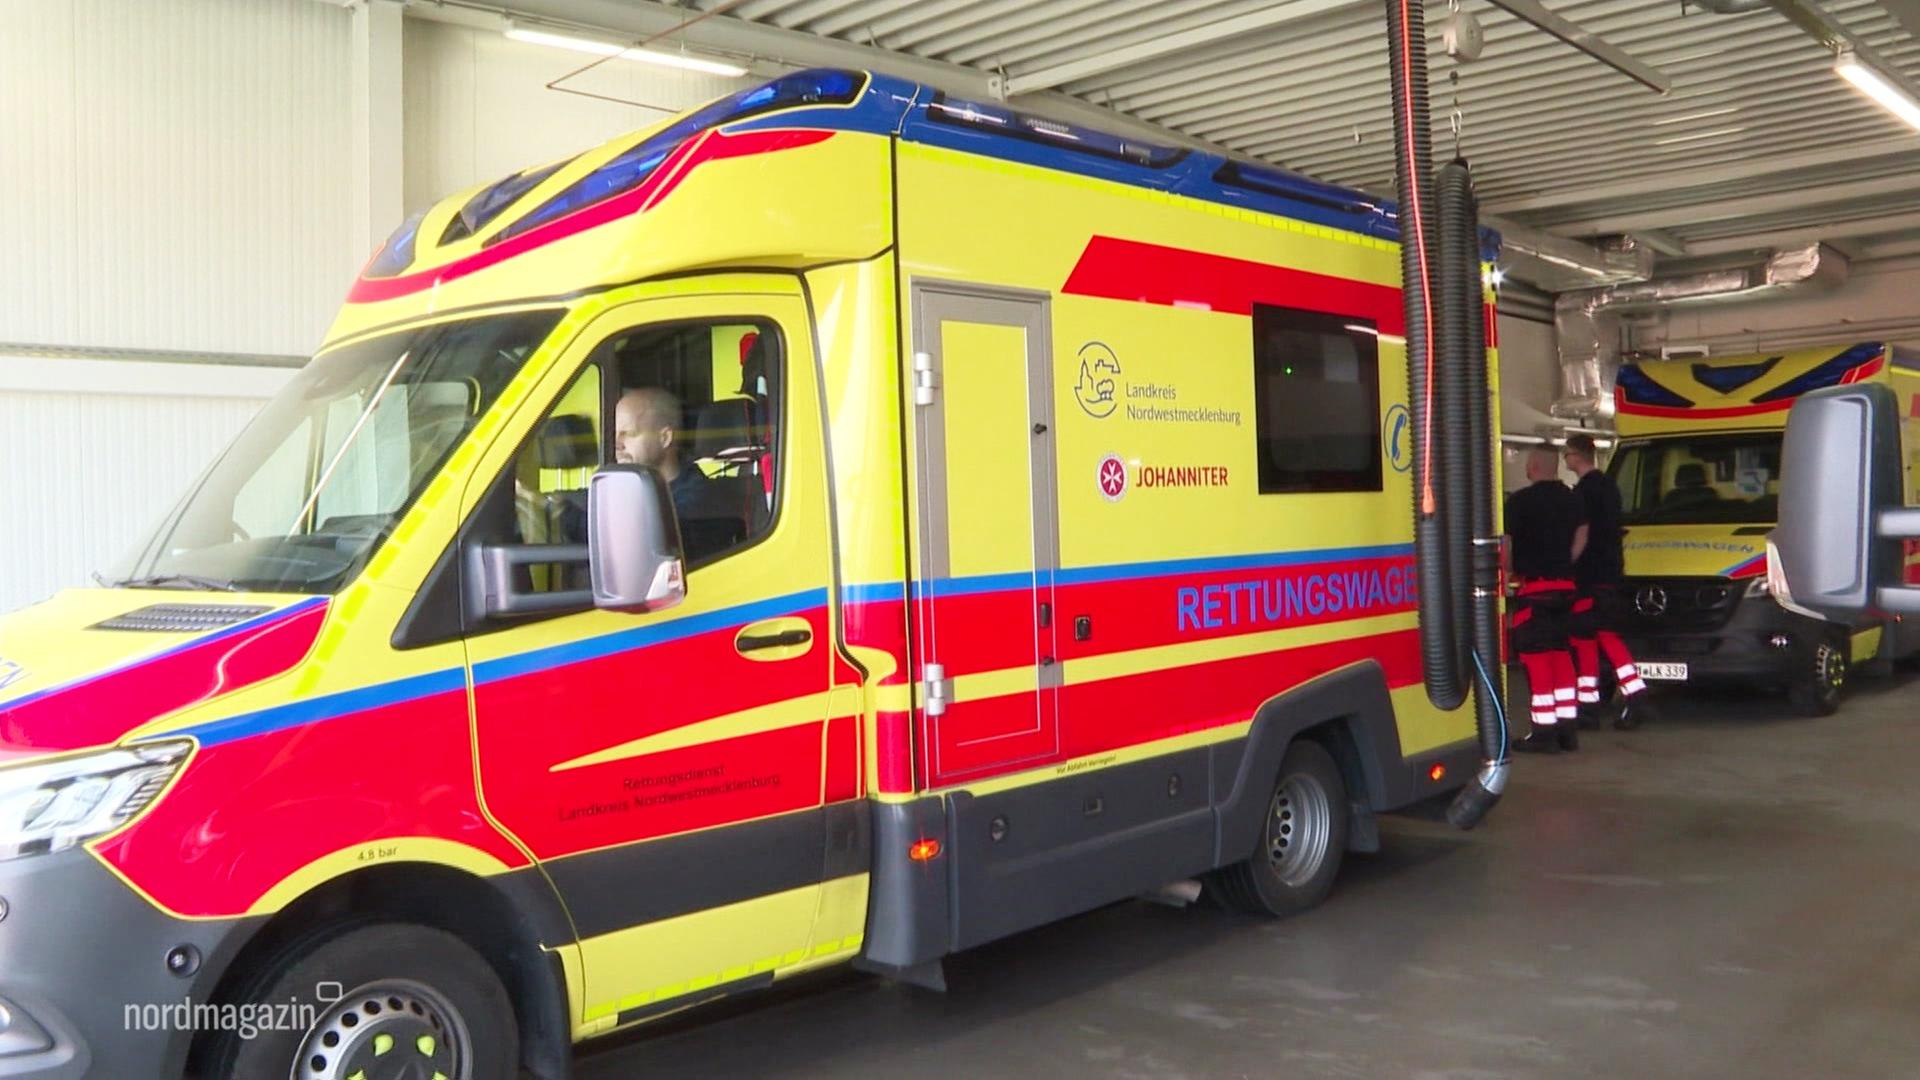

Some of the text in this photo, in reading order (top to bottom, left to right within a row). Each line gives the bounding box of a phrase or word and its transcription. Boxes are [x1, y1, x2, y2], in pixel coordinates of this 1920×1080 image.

[1126, 383, 1177, 400] Landkreis
[1127, 404, 1242, 426] Nordwestmecklenburg
[1136, 466, 1229, 488] JOHANNITER
[1177, 565, 1418, 632] RETTUNGSWAGE
[1666, 664, 1686, 678] 339
[623, 765, 726, 791] Rettungsdienst
[559, 773, 781, 822] Landkreis Nordwestmecklenburg
[378, 847, 399, 858] bar
